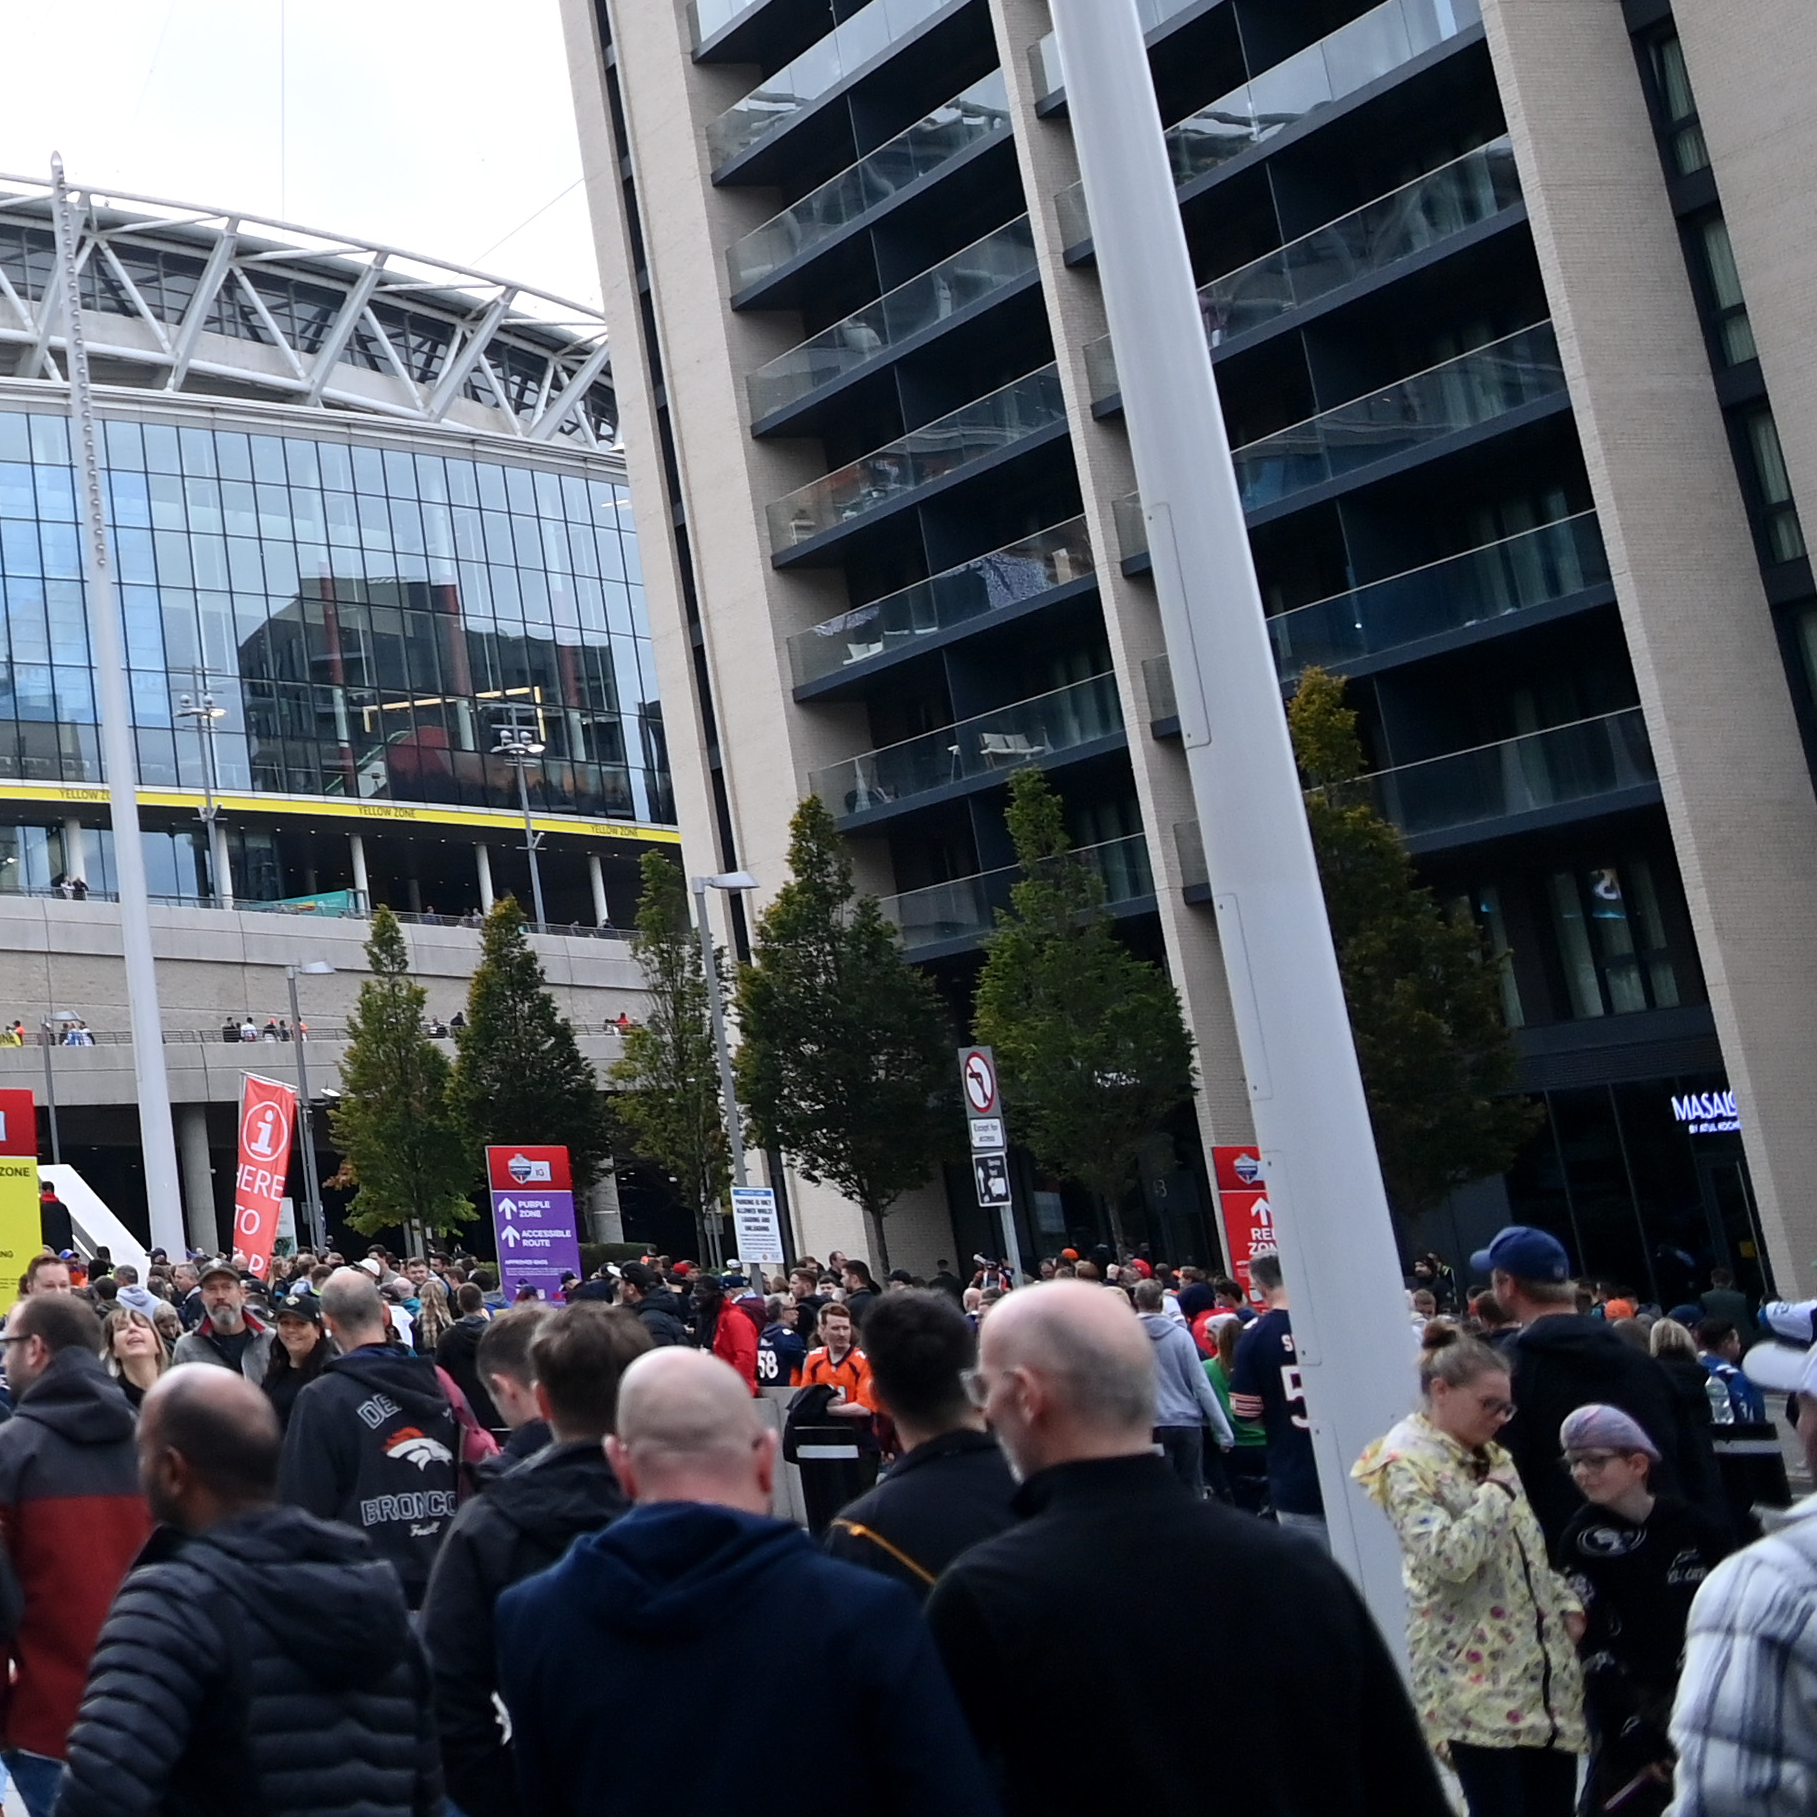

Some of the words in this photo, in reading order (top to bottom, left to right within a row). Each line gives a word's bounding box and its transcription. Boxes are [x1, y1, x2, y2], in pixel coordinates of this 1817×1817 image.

[59, 789, 96, 800] YELLOW
[358, 805, 391, 817] YELLOW
[393, 807, 416, 819] ZONE
[590, 824, 614, 835] YELLOW
[616, 826, 639, 837] ZONE
[518, 1200, 551, 1209] PURPLE
[519, 1209, 542, 1218] ZONE
[521, 1229, 572, 1238] ACCESSIBLE
[522, 1239, 551, 1247] ROUTE
